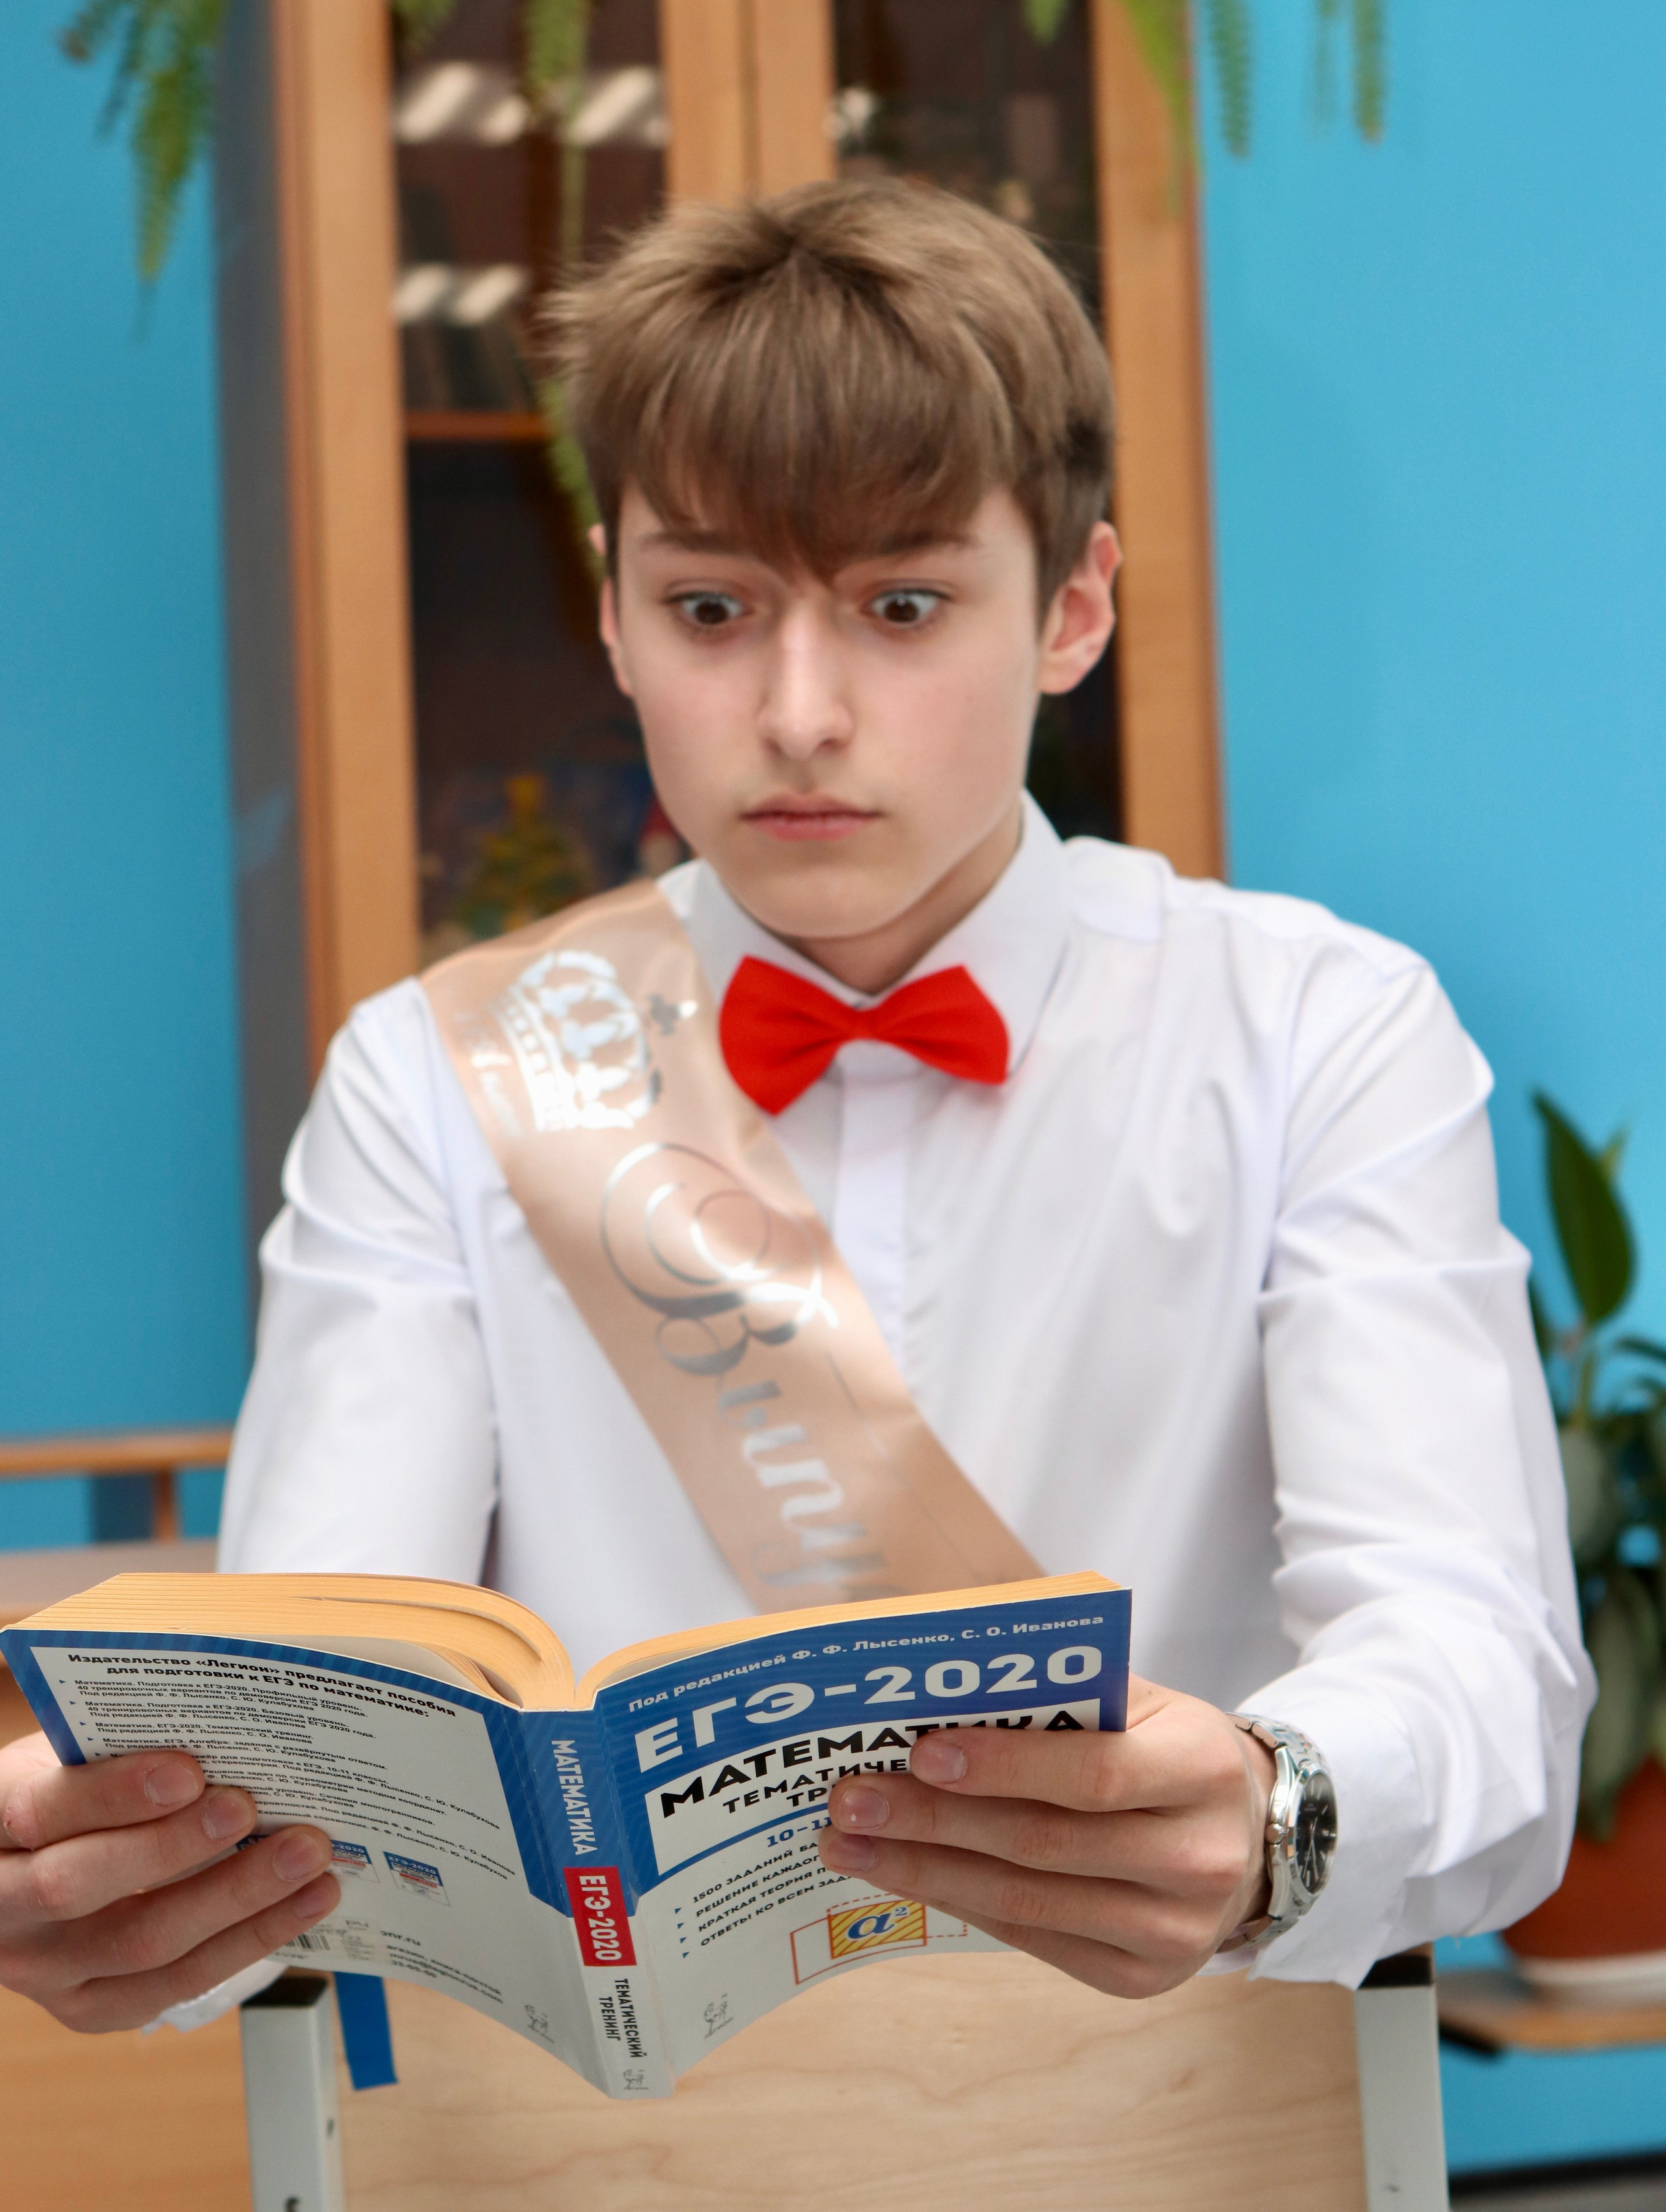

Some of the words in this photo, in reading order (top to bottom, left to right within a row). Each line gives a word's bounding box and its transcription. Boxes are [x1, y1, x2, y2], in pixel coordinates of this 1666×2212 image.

[629, 1691, 668, 1712] Под
[674, 1655, 785, 1697] редакцией
[792, 1650, 817, 1659] Ф.
[823, 1645, 847, 1654] Ф.
[853, 1634, 955, 1650] Лысенко,
[961, 1630, 979, 1639] С.
[987, 1627, 1006, 1636] О.
[1013, 1617, 1103, 1634] Иванова
[68, 1654, 191, 1665] Издательство
[196, 1659, 279, 1674] «Легион»
[285, 1670, 382, 1695] предлагает
[388, 1691, 456, 1717] пособия
[144, 1668, 244, 1679] подготовки
[264, 1676, 294, 1686] ЕГЭ
[299, 1682, 318, 1691] по
[324, 1687, 429, 1717] математике:
[239, 1693, 297, 1704] демоверсии
[321, 1702, 341, 1711] 2020
[253, 1688, 317, 1701] Профильный
[320, 1699, 361, 1710] уровень.
[249, 1714, 305, 1723] демоверсии
[262, 1709, 304, 1718] Базовый
[307, 1717, 348, 1728] уровень.
[265, 1718, 305, 1728] Иванова
[635, 1646, 1102, 1773] ЕГЭ-2020
[206, 1725, 272, 1734] Тематический
[275, 1731, 314, 1741] тренинг.
[271, 1734, 312, 1743] Иванова
[212, 1758, 280, 1768] стереометрия.
[304, 1766, 352, 1779] редакцией
[283, 1747, 345, 1760] развёрнутым
[348, 1758, 387, 1769] ответом.
[303, 1763, 324, 1771] ЕГЭ.
[352, 1773, 389, 1786] классы.
[290, 1776, 354, 1789] стереометрии
[357, 1788, 396, 1799] методом
[398, 1798, 446, 1815] координат.
[551, 1740, 597, 1855] МАТЕМАТИКА
[314, 1816, 369, 1829] справочник.
[342, 1812, 389, 1825] редакцией
[481, 1854, 515, 1875] Иванова
[693, 1883, 722, 1903] 1500
[726, 1850, 793, 1885] ЗАДАНИЙ
[579, 1875, 622, 1961] ЕГЭ-2020
[696, 1881, 759, 1917] РЕШЕНИЕ
[699, 1896, 756, 1932] КРАТКАЯ
[760, 1872, 812, 1898] ТЕОРИЯ
[701, 1914, 752, 1946] ОТВЕТЫ
[756, 1904, 774, 1915] КО
[778, 1885, 814, 1905] ВСЕМ
[599, 1997, 621, 2041] ТРЕНИНГ
[615, 1978, 647, 2058] ТЕМАТИЧЕСКИЙ
